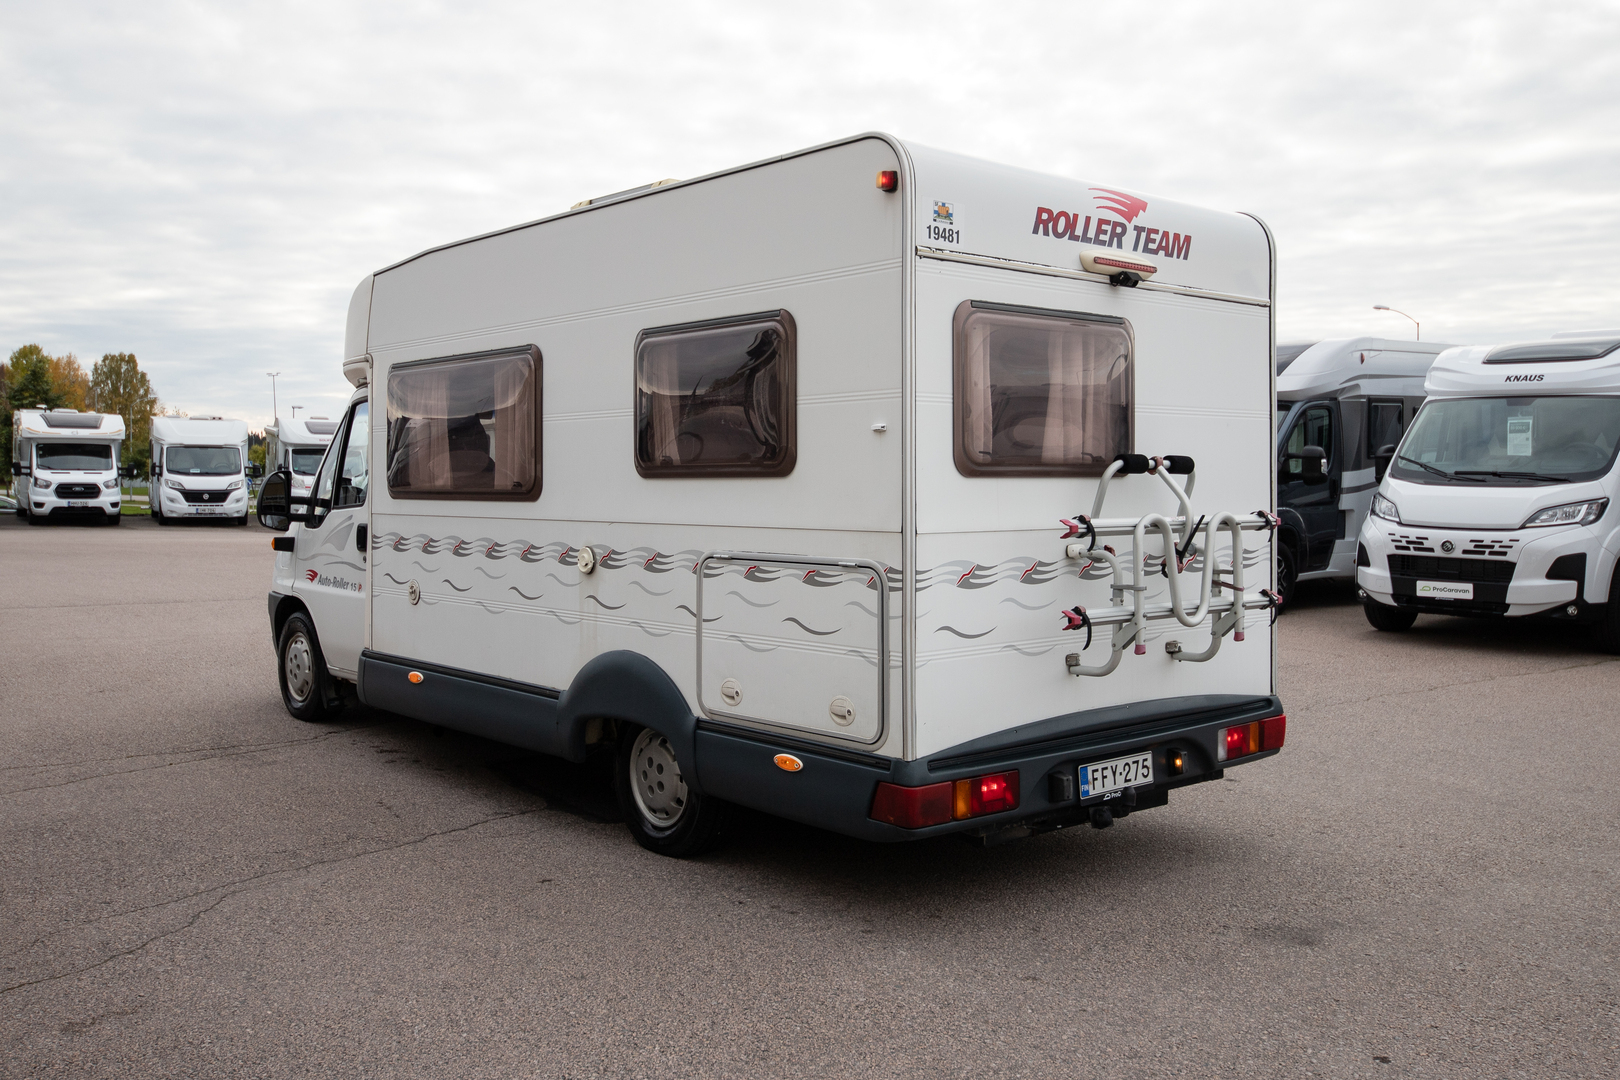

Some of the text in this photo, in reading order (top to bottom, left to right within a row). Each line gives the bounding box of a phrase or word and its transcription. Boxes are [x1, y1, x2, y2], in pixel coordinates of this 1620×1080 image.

[926, 224, 960, 244] 19481
[1032, 207, 1192, 260] ROLLER TEAM
[1504, 374, 1545, 382] KNAUS
[317, 574, 350, 590] Auto-Roller
[350, 582, 357, 592] 15
[1433, 586, 1470, 594] ProCaravan
[1091, 758, 1150, 791] FFY-275
[1081, 784, 1089, 792] FIN
